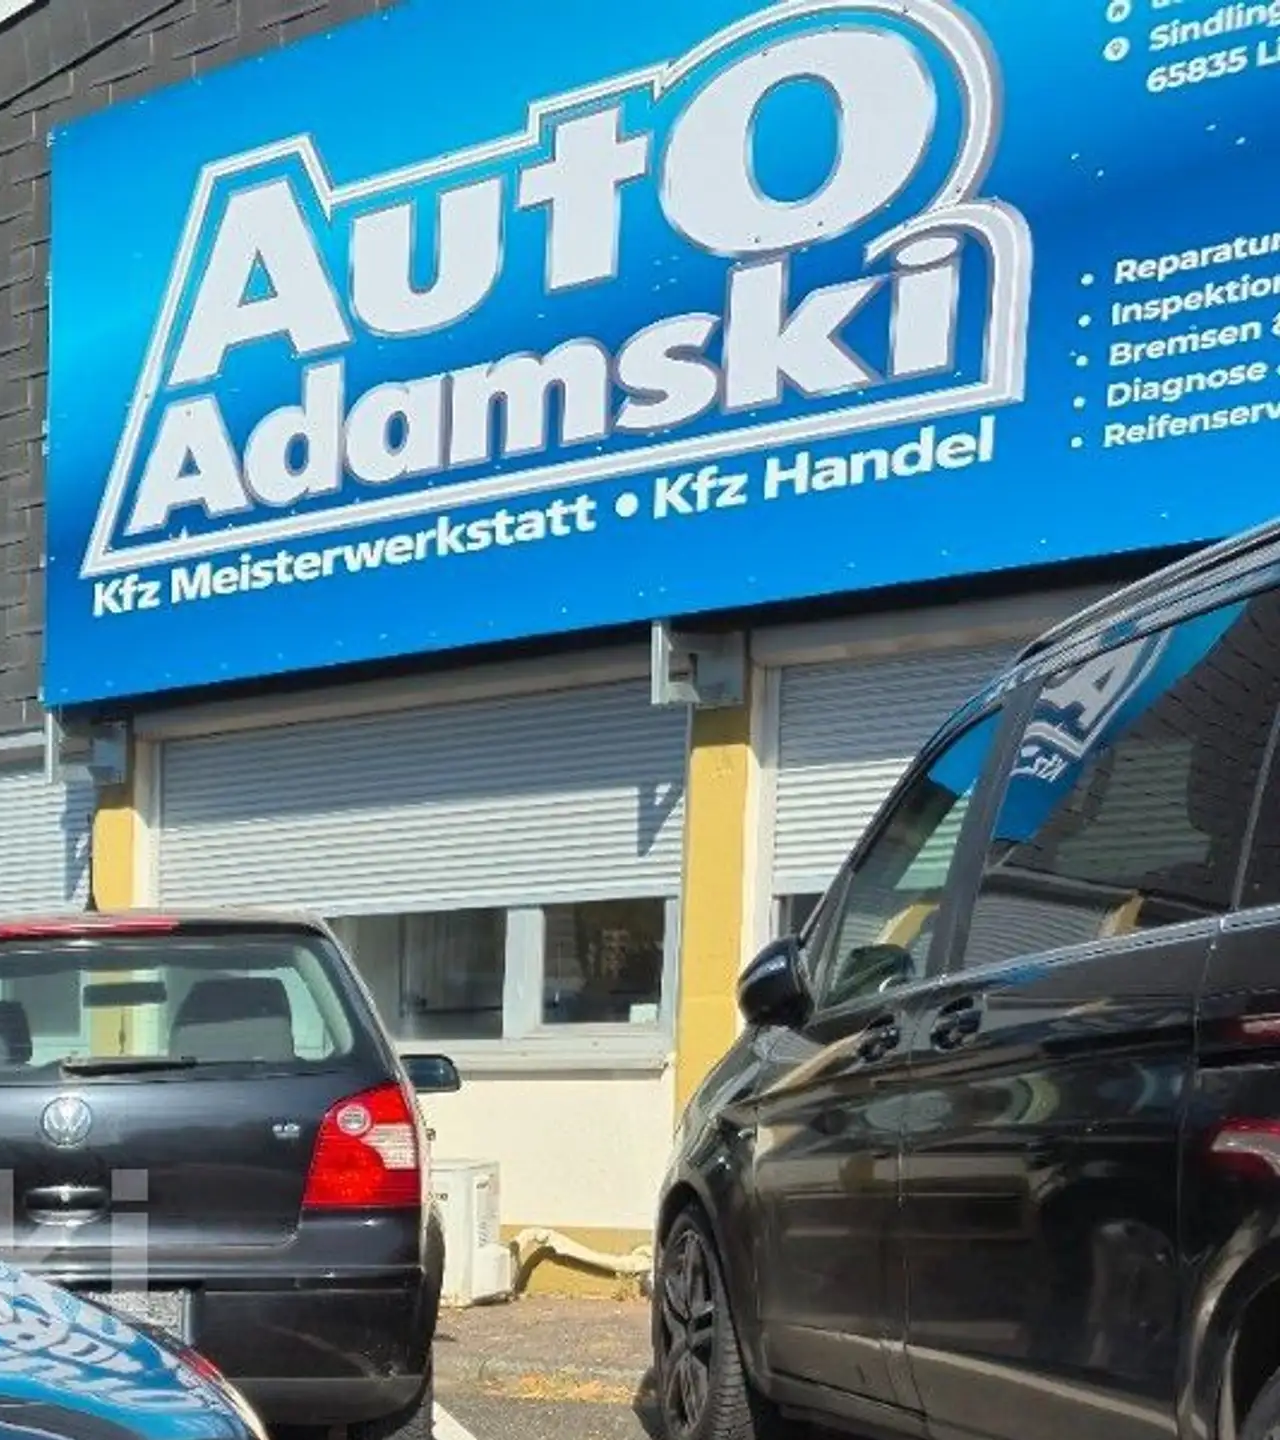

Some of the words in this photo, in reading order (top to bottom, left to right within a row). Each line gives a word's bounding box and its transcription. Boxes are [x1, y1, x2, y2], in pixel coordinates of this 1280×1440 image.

[1146, 46, 1248, 93] 65835
[168, 27, 938, 386] AutO
[1109, 321, 1262, 367] Bremsen
[127, 233, 963, 537] Adamski
[1107, 361, 1268, 408] Diagnose
[1103, 401, 1280, 448] Reifenserv
[91, 560, 162, 617] Kfz
[168, 493, 598, 602] Meisterwerkstatt
[651, 469, 750, 520] Kfz
[762, 419, 997, 501] Handel
